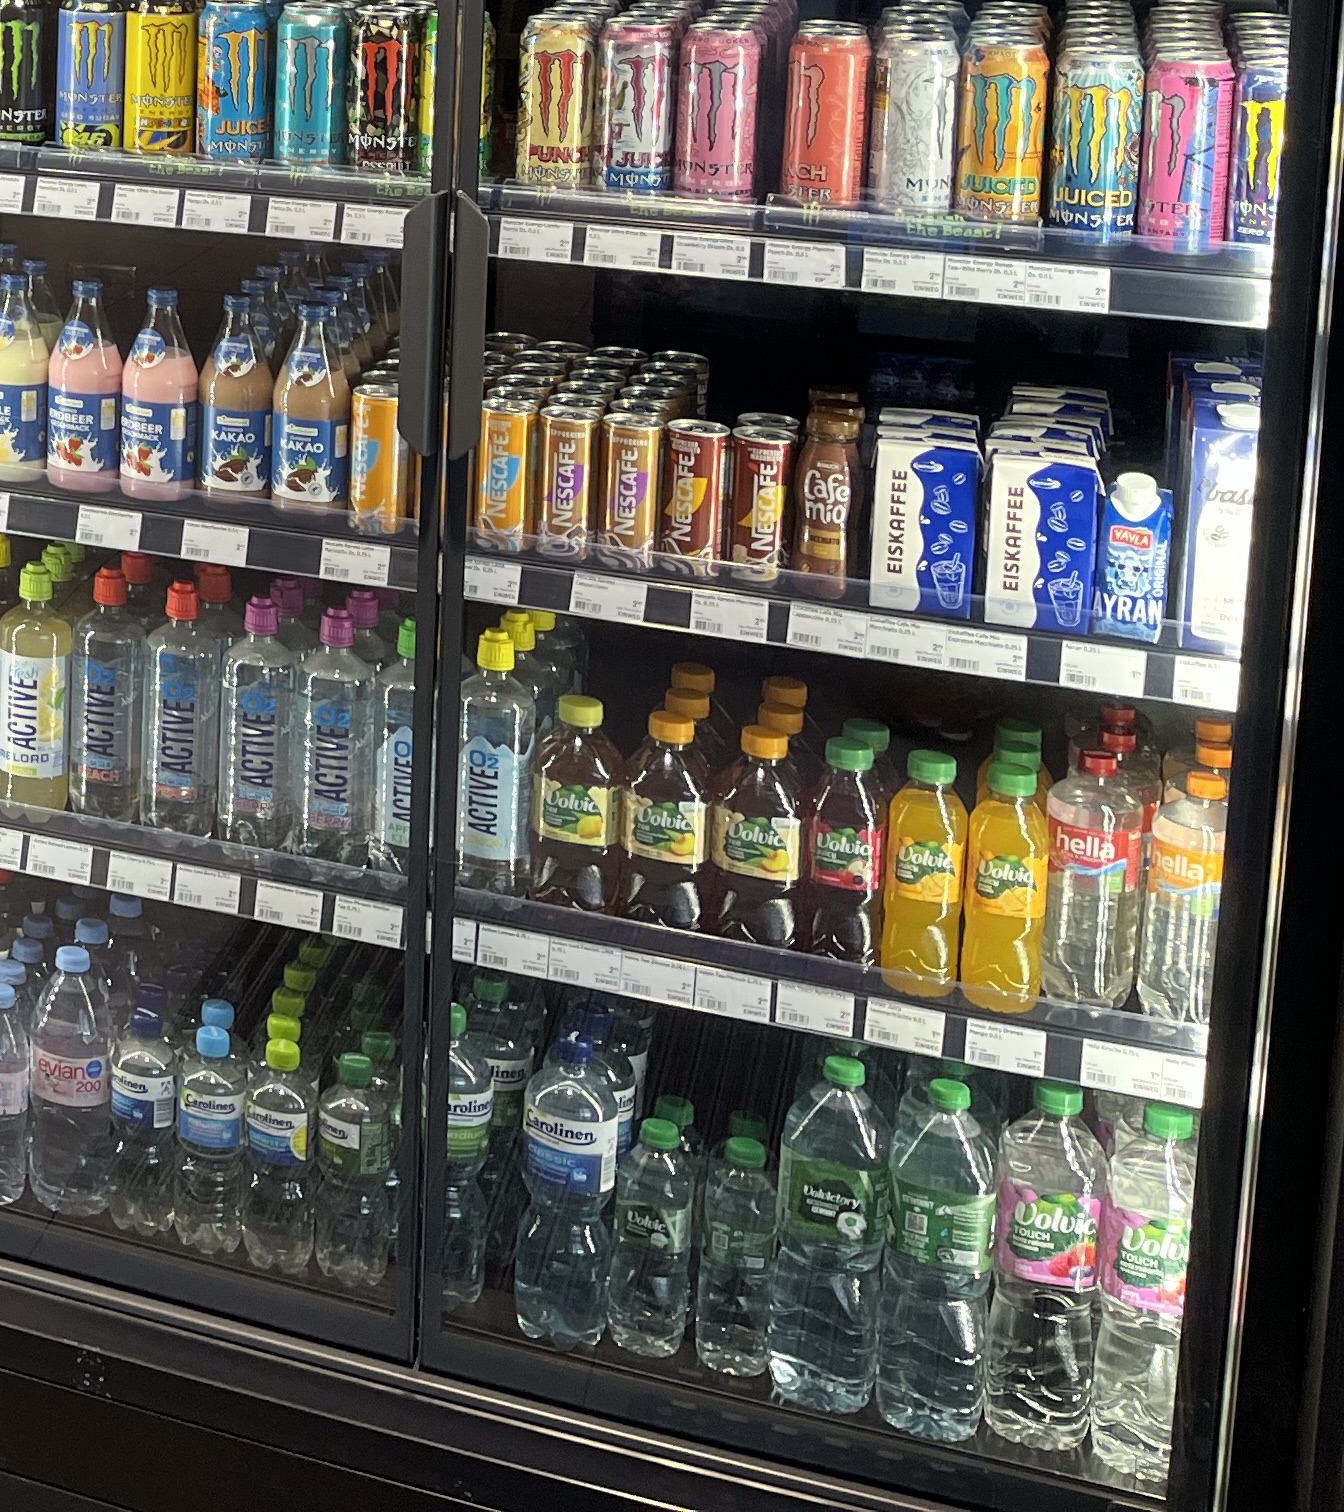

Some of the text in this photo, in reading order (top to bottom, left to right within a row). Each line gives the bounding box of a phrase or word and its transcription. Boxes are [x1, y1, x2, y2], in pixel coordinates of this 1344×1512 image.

[58, 90, 122, 105] MONSTER
[963, 177, 1038, 195] JUICED
[1054, 188, 1133, 208] JUICED
[1049, 210, 1134, 228] MONSTER
[49, 408, 94, 425] ERDBEER
[212, 430, 256, 444] KAKAO
[281, 438, 325, 454] KAKAO
[887, 469, 908, 575] EISKAFFEE
[1003, 486, 1025, 592] EISKAFFEE
[1154, 540, 1168, 598] ORIGINAL
[1093, 591, 1163, 625] AYRAN
[7, 676, 38, 751] ACTIVE
[86, 684, 116, 757] ACTIVE
[161, 699, 195, 775] ACTIVE
[240, 711, 276, 788] ACTIVE
[314, 724, 350, 803] ACTIVE
[468, 766, 499, 836] ACTIVE
[546, 789, 599, 813] Volvic
[637, 806, 692, 832] Volvic
[729, 821, 787, 846] Volvic
[815, 830, 873, 858] Volvic
[1055, 825, 1115, 859] hella
[898, 844, 952, 869] Volvic
[1151, 848, 1204, 882] hella
[978, 857, 1034, 883] Volvic
[38, 1056, 87, 1082] evian
[76, 1080, 102, 1093] 200
[186, 1092, 237, 1114] Carolinen
[525, 1107, 597, 1144] Carolinen
[528, 1142, 576, 1168] classic
[627, 1210, 667, 1233] Volvic
[1014, 1201, 1097, 1236] Volvic
[1014, 1227, 1051, 1242] TOUCH
[1121, 1253, 1159, 1268] TOUCH
